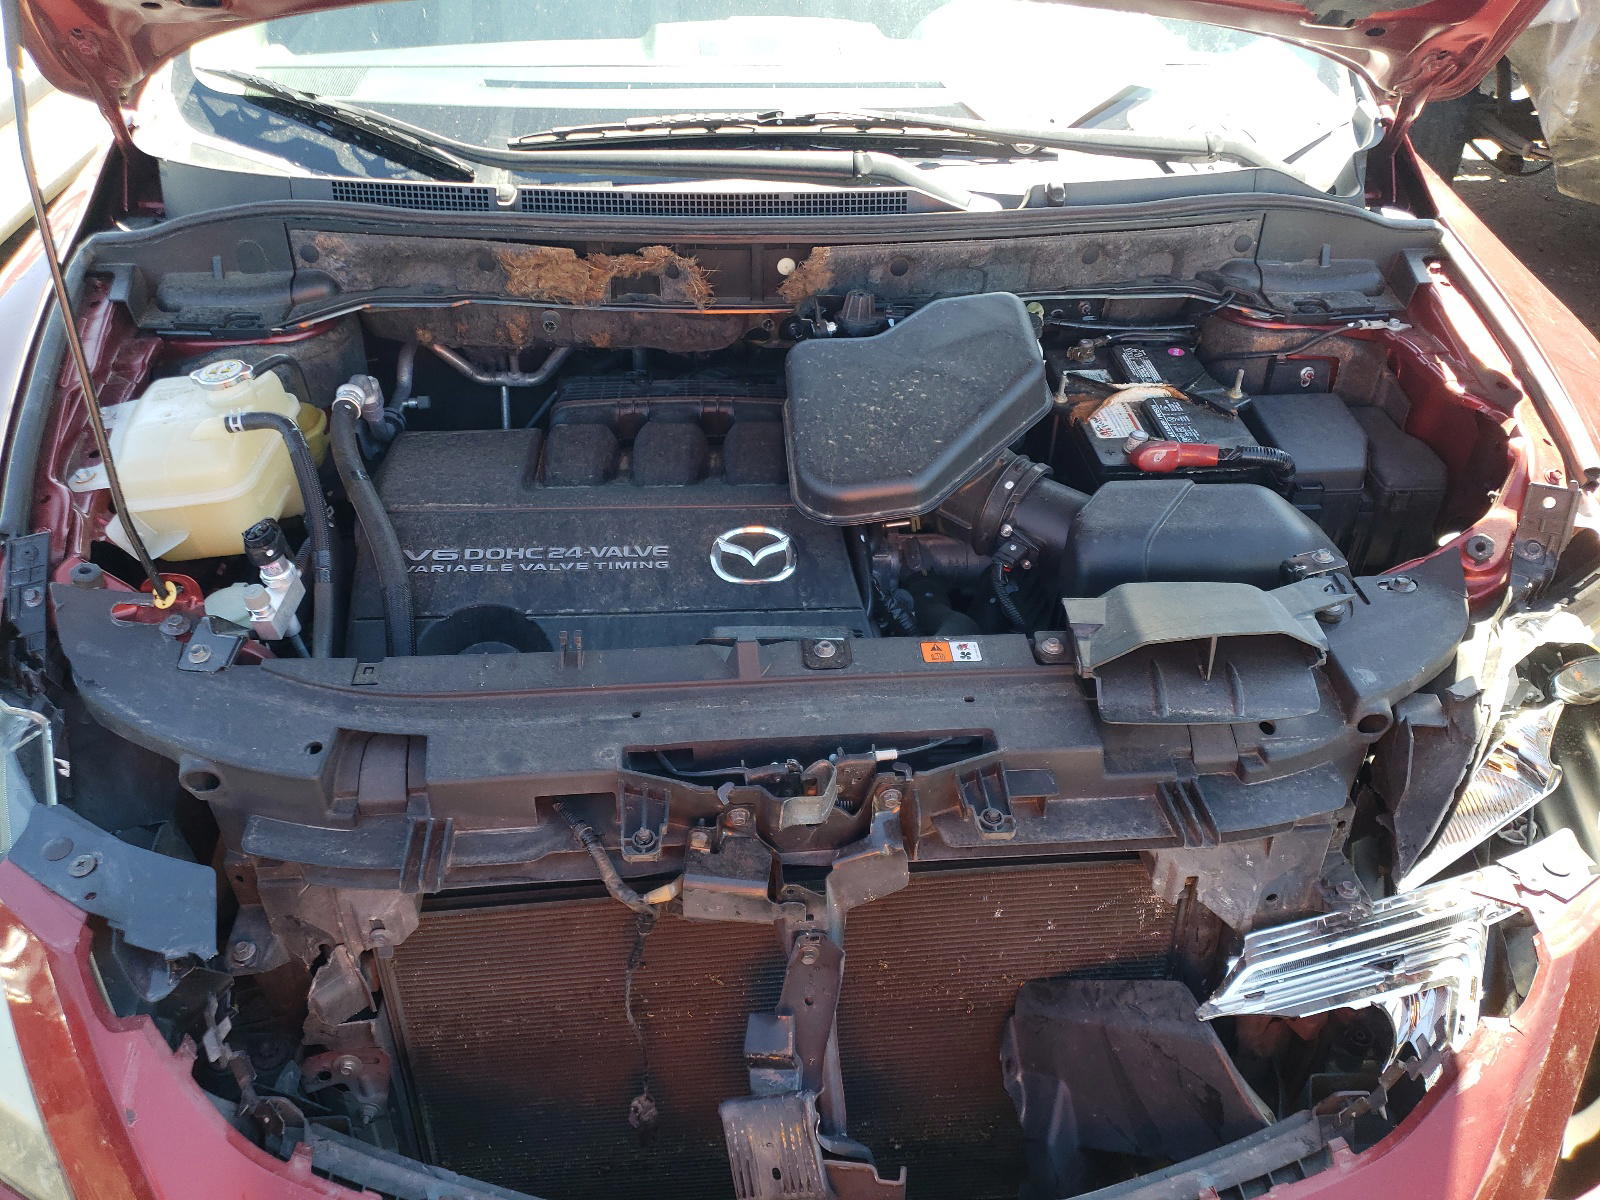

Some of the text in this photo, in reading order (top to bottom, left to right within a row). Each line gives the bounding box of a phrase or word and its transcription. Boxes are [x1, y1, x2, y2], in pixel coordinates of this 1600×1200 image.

[403, 545, 670, 561] V6 DOHC 24-VALVE
[519, 562, 589, 571] VALVE
[593, 560, 669, 570] TIMING
